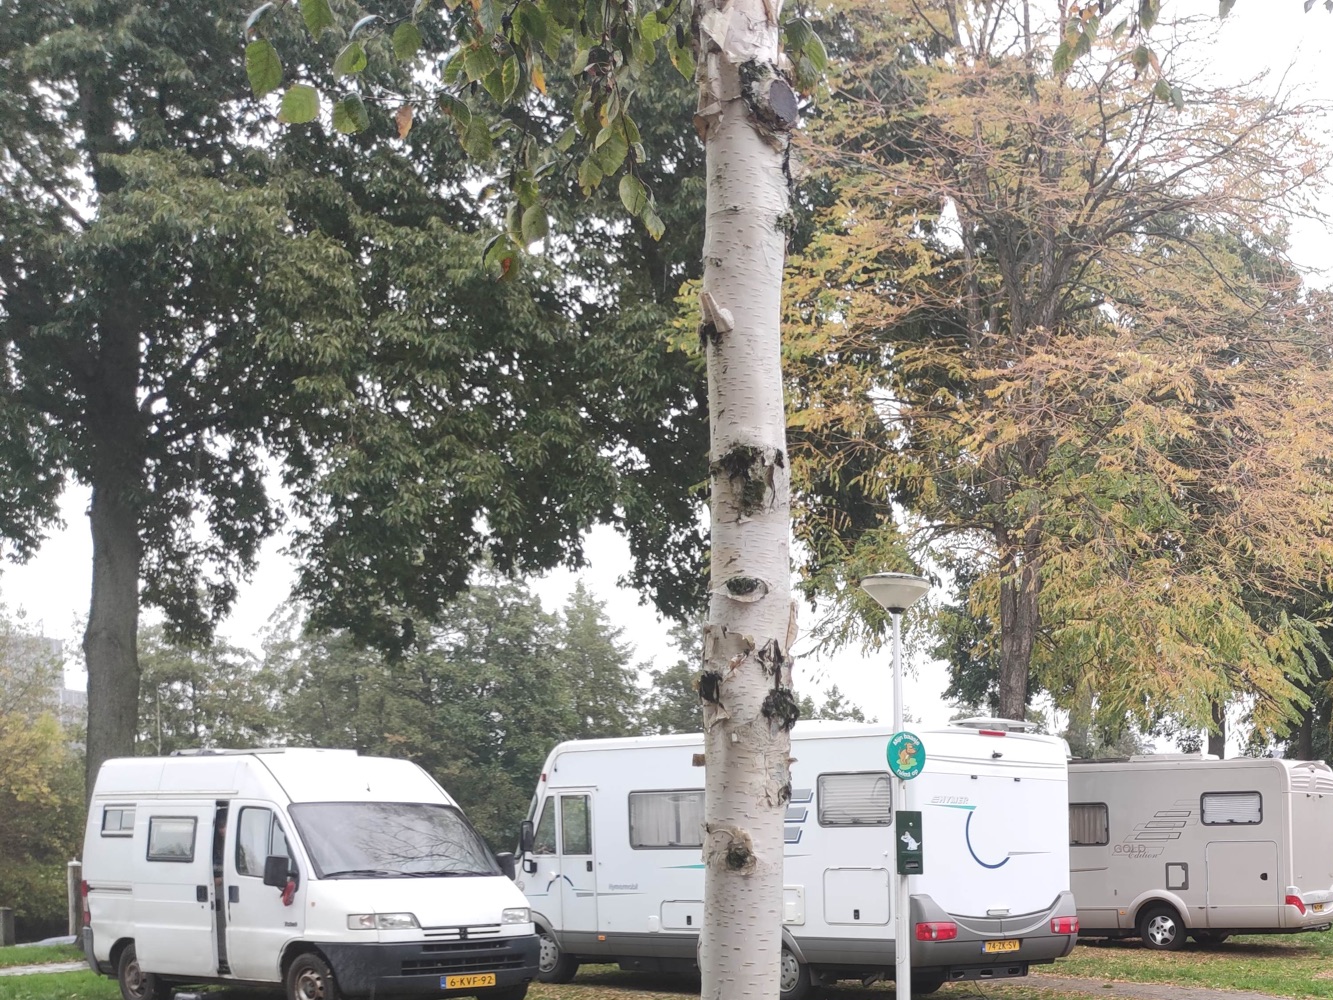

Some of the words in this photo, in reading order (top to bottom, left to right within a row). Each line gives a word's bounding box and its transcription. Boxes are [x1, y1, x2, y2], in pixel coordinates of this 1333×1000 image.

[1114, 844, 1146, 853] GOLD
[1128, 851, 1158, 859] Edition
[450, 975, 493, 987] 6-KVF-92
